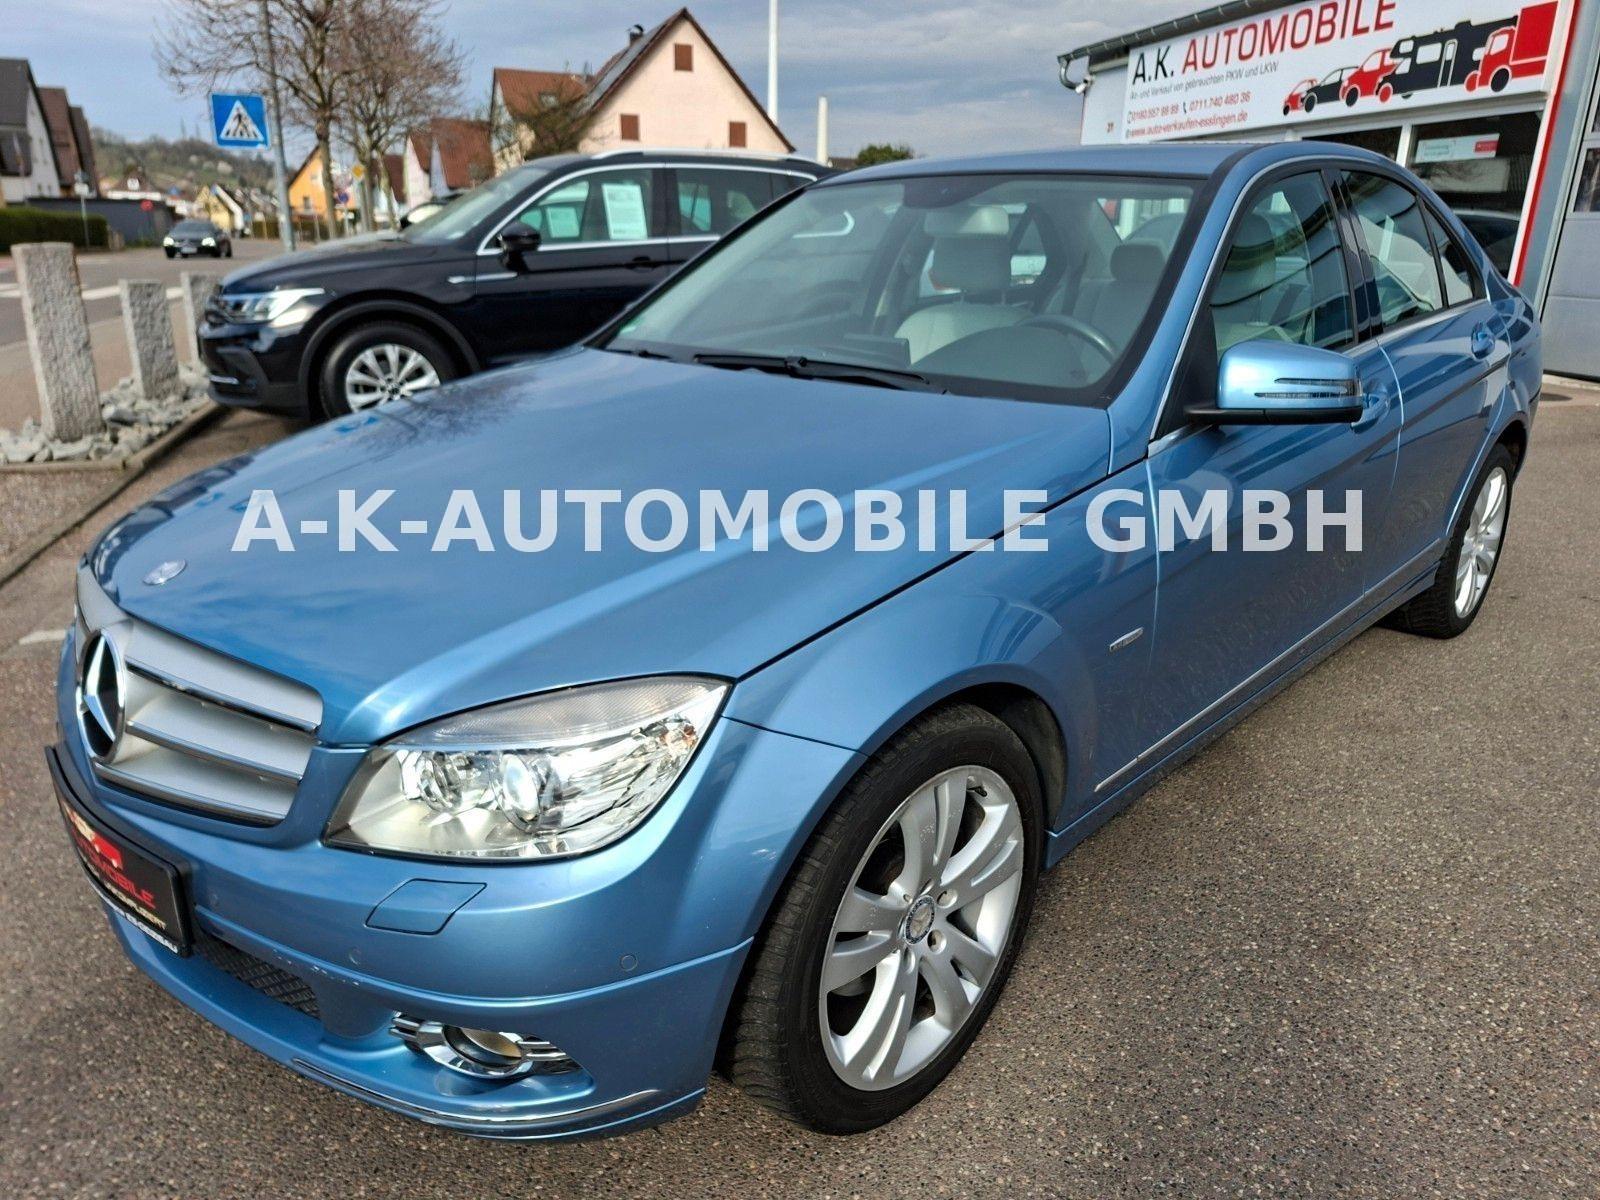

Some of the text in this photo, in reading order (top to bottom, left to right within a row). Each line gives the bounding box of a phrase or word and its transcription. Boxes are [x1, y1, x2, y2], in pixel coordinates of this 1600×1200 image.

[1132, 0, 1397, 85] A.K. AUTOMOBILE
[1226, 68, 1244, 81] PKW
[1245, 66, 1258, 78] und
[1260, 61, 1279, 75] LKW
